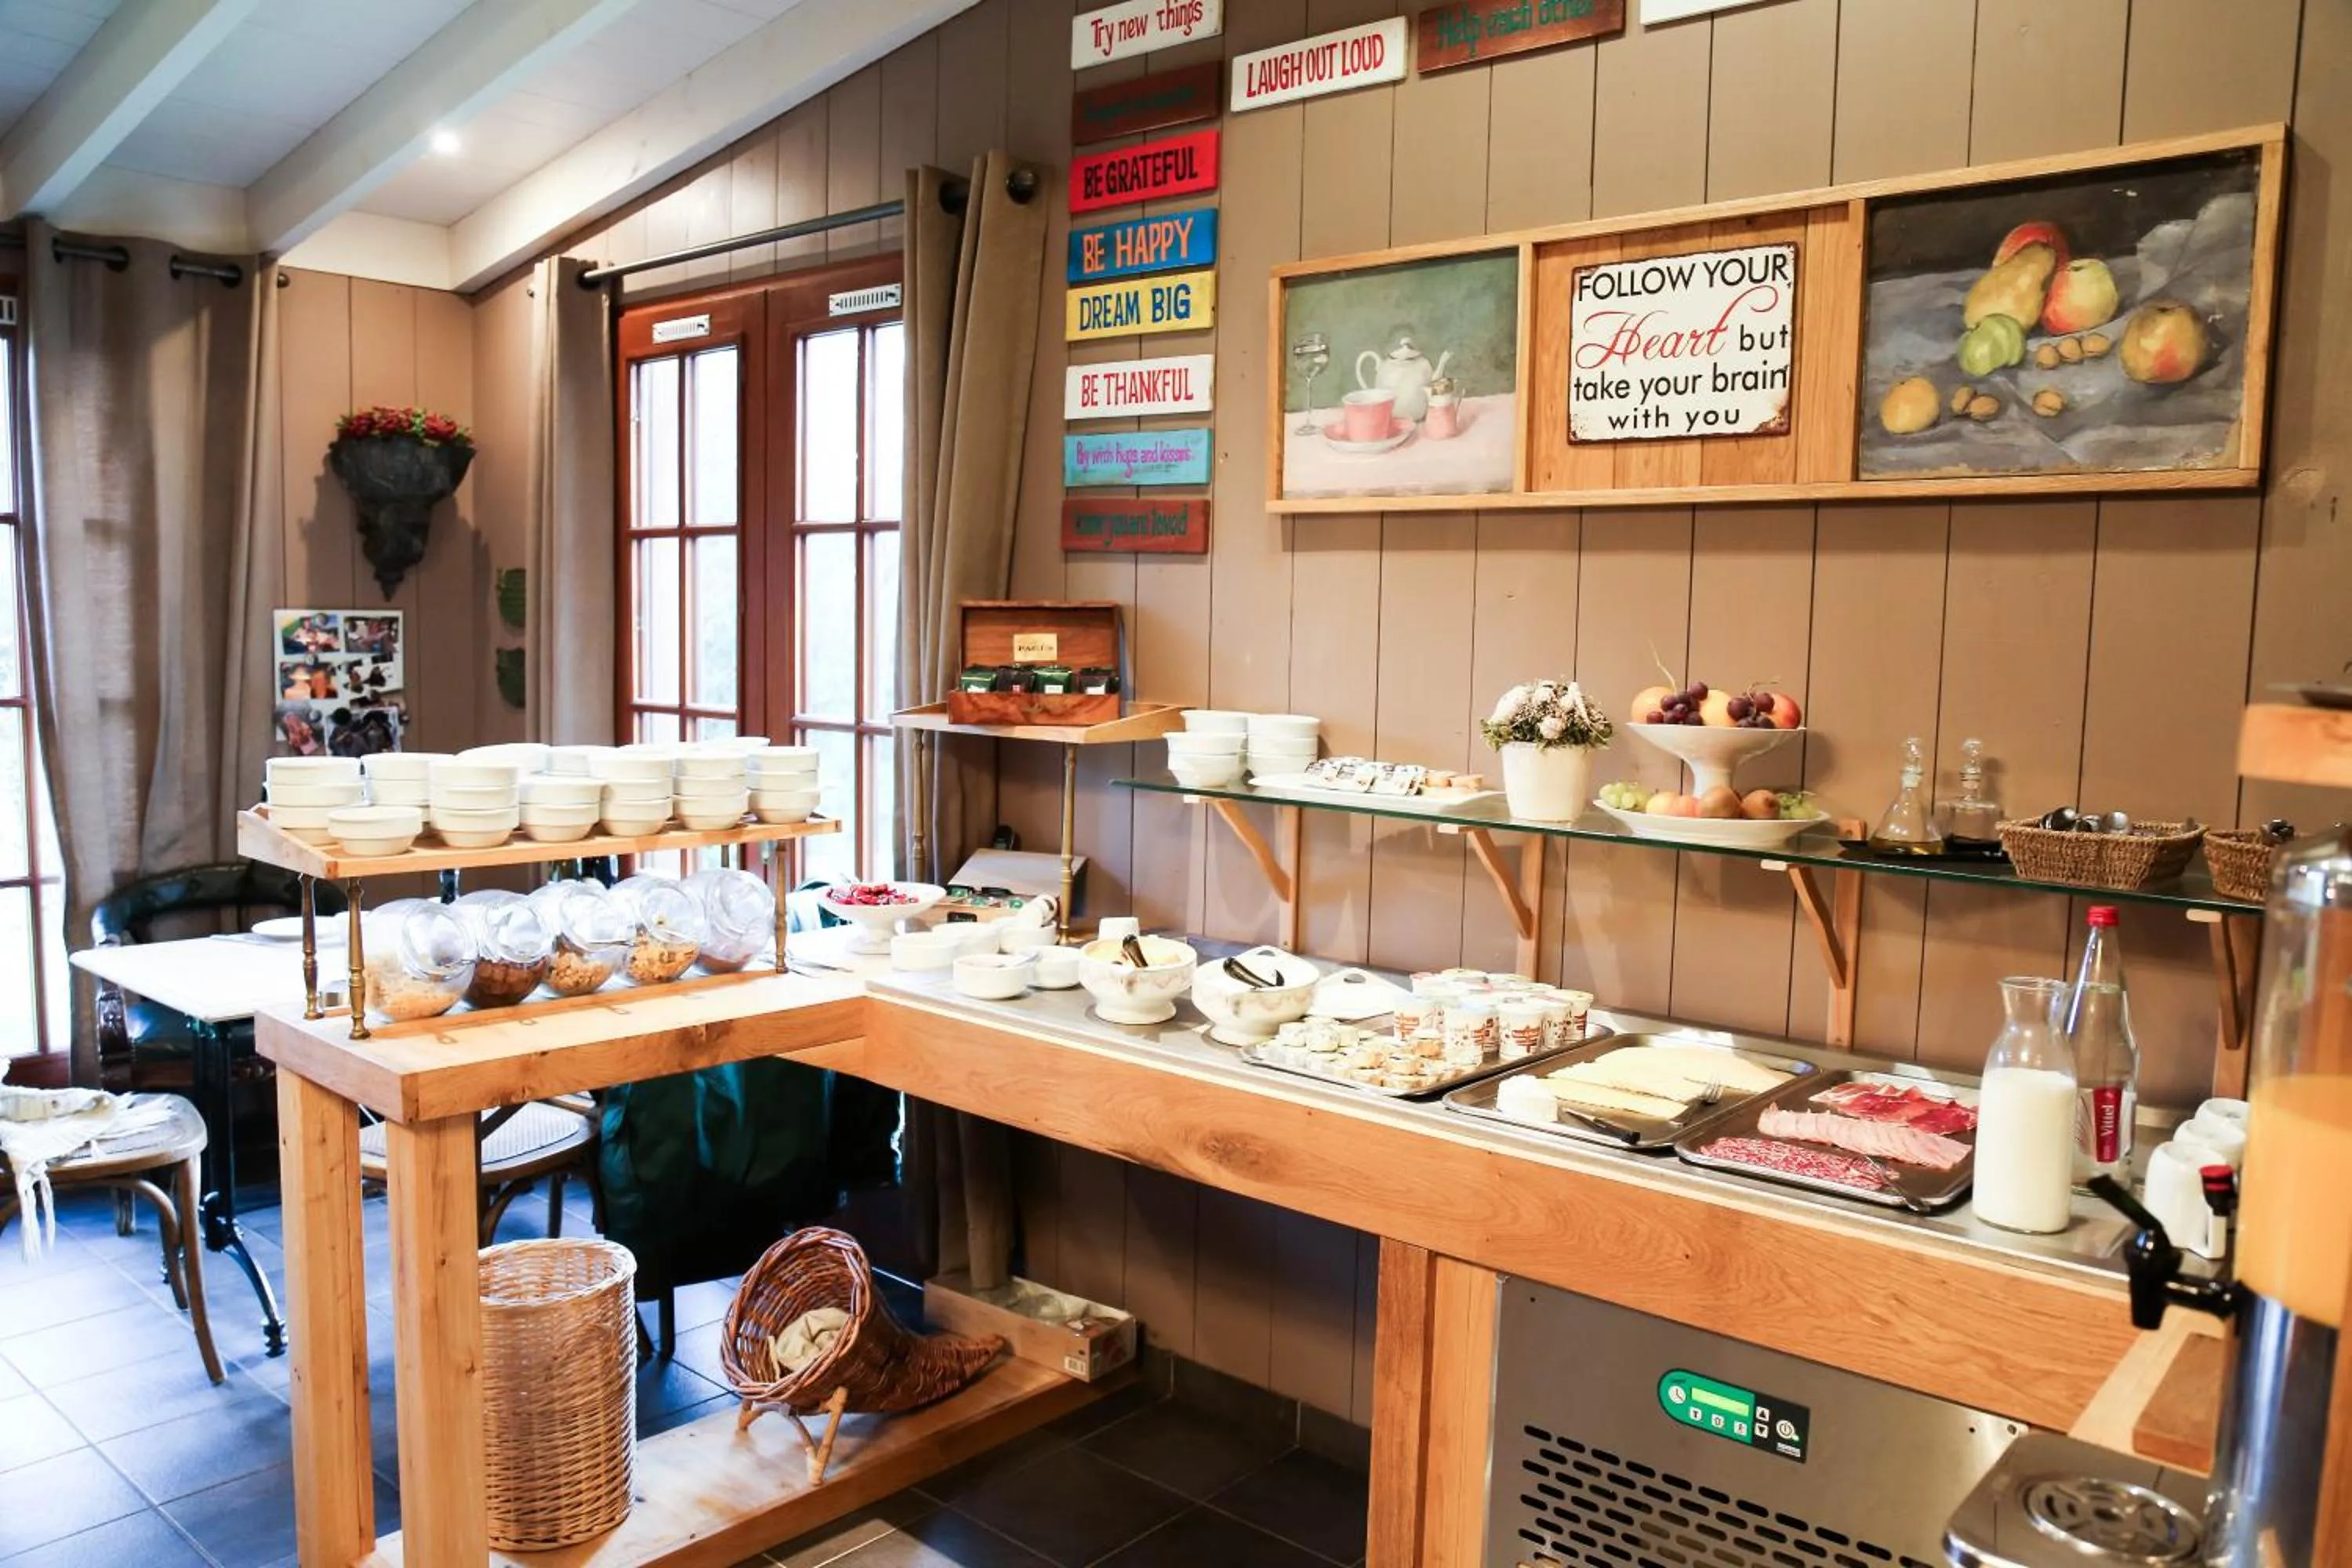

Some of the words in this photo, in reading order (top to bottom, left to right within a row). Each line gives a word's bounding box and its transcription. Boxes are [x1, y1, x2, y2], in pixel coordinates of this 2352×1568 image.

[1091, 19, 1114, 56] Try
[1119, 14, 1149, 42] new
[1156, 0, 1203, 36] things
[1436, 3, 1480, 60] Help
[1487, 0, 1533, 38] each
[1246, 50, 1302, 98] LAUGH
[1306, 40, 1338, 82] OUT
[1341, 34, 1385, 76] LOUD
[1083, 162, 1103, 200] BE
[1105, 145, 1198, 195] GRATEFUL
[1083, 232, 1105, 274] BE
[1116, 217, 1194, 269] HAPPY
[1578, 263, 1697, 301] FOLLOW
[1703, 253, 1789, 288] YOUR
[1079, 290, 1142, 332] DREAM
[1151, 283, 1192, 324] BIG
[1575, 285, 1779, 369] Heart
[1739, 324, 1789, 352] but
[1081, 374, 1098, 408] BE
[1103, 368, 1194, 405] THANKFUL
[1573, 370, 1631, 401] take
[1639, 374, 1703, 405] your
[1711, 360, 1789, 394] brain
[1607, 405, 1670, 430] with
[1685, 408, 1740, 433] you
[1116, 441, 1138, 478] hugs
[1141, 440, 1158, 463] and
